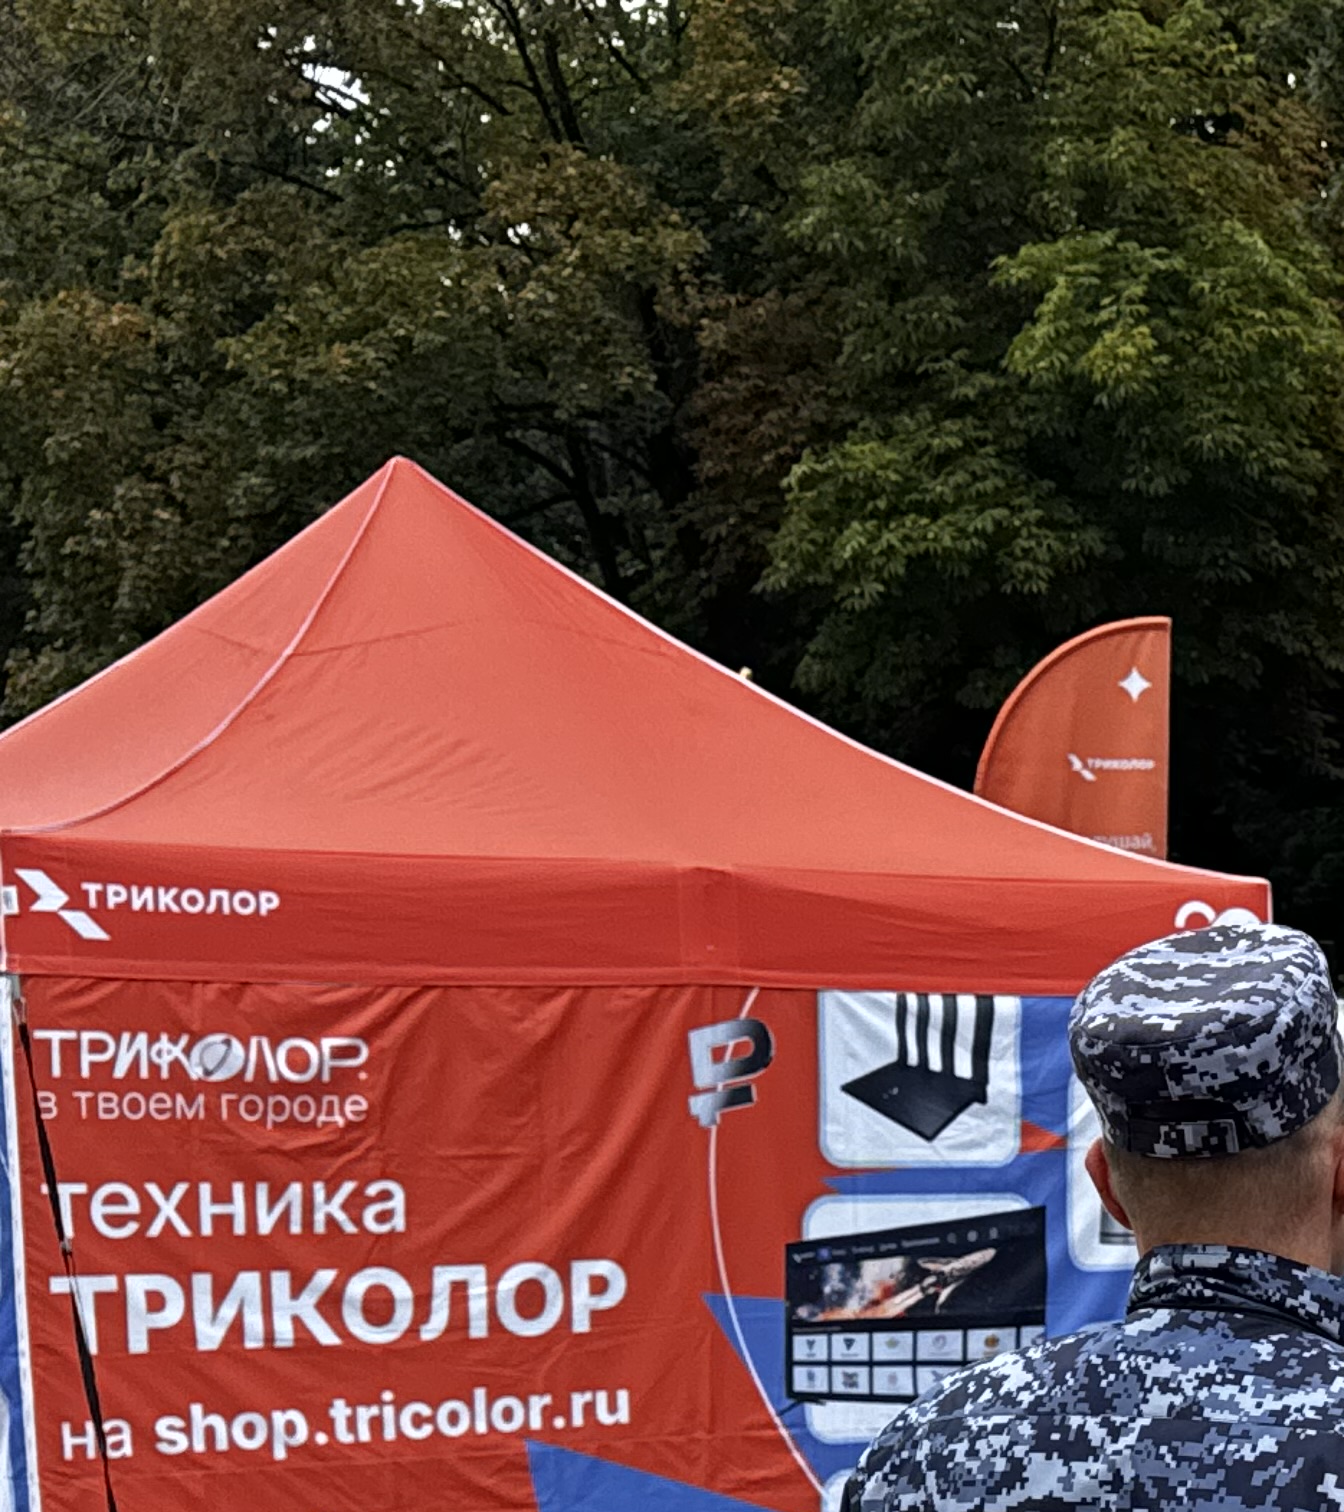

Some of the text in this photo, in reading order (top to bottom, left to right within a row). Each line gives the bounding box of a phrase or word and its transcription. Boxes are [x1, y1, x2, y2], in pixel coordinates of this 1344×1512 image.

[81, 882, 280, 916] ТРИКОЛОР
[33, 1029, 367, 1082] ТРИКОЛОР
[37, 1091, 368, 1129] в твоем городе
[41, 1179, 407, 1240] техника
[49, 1259, 628, 1355] ТРИКОЛОР
[61, 1386, 630, 1460] на shop.tricolor.ru
